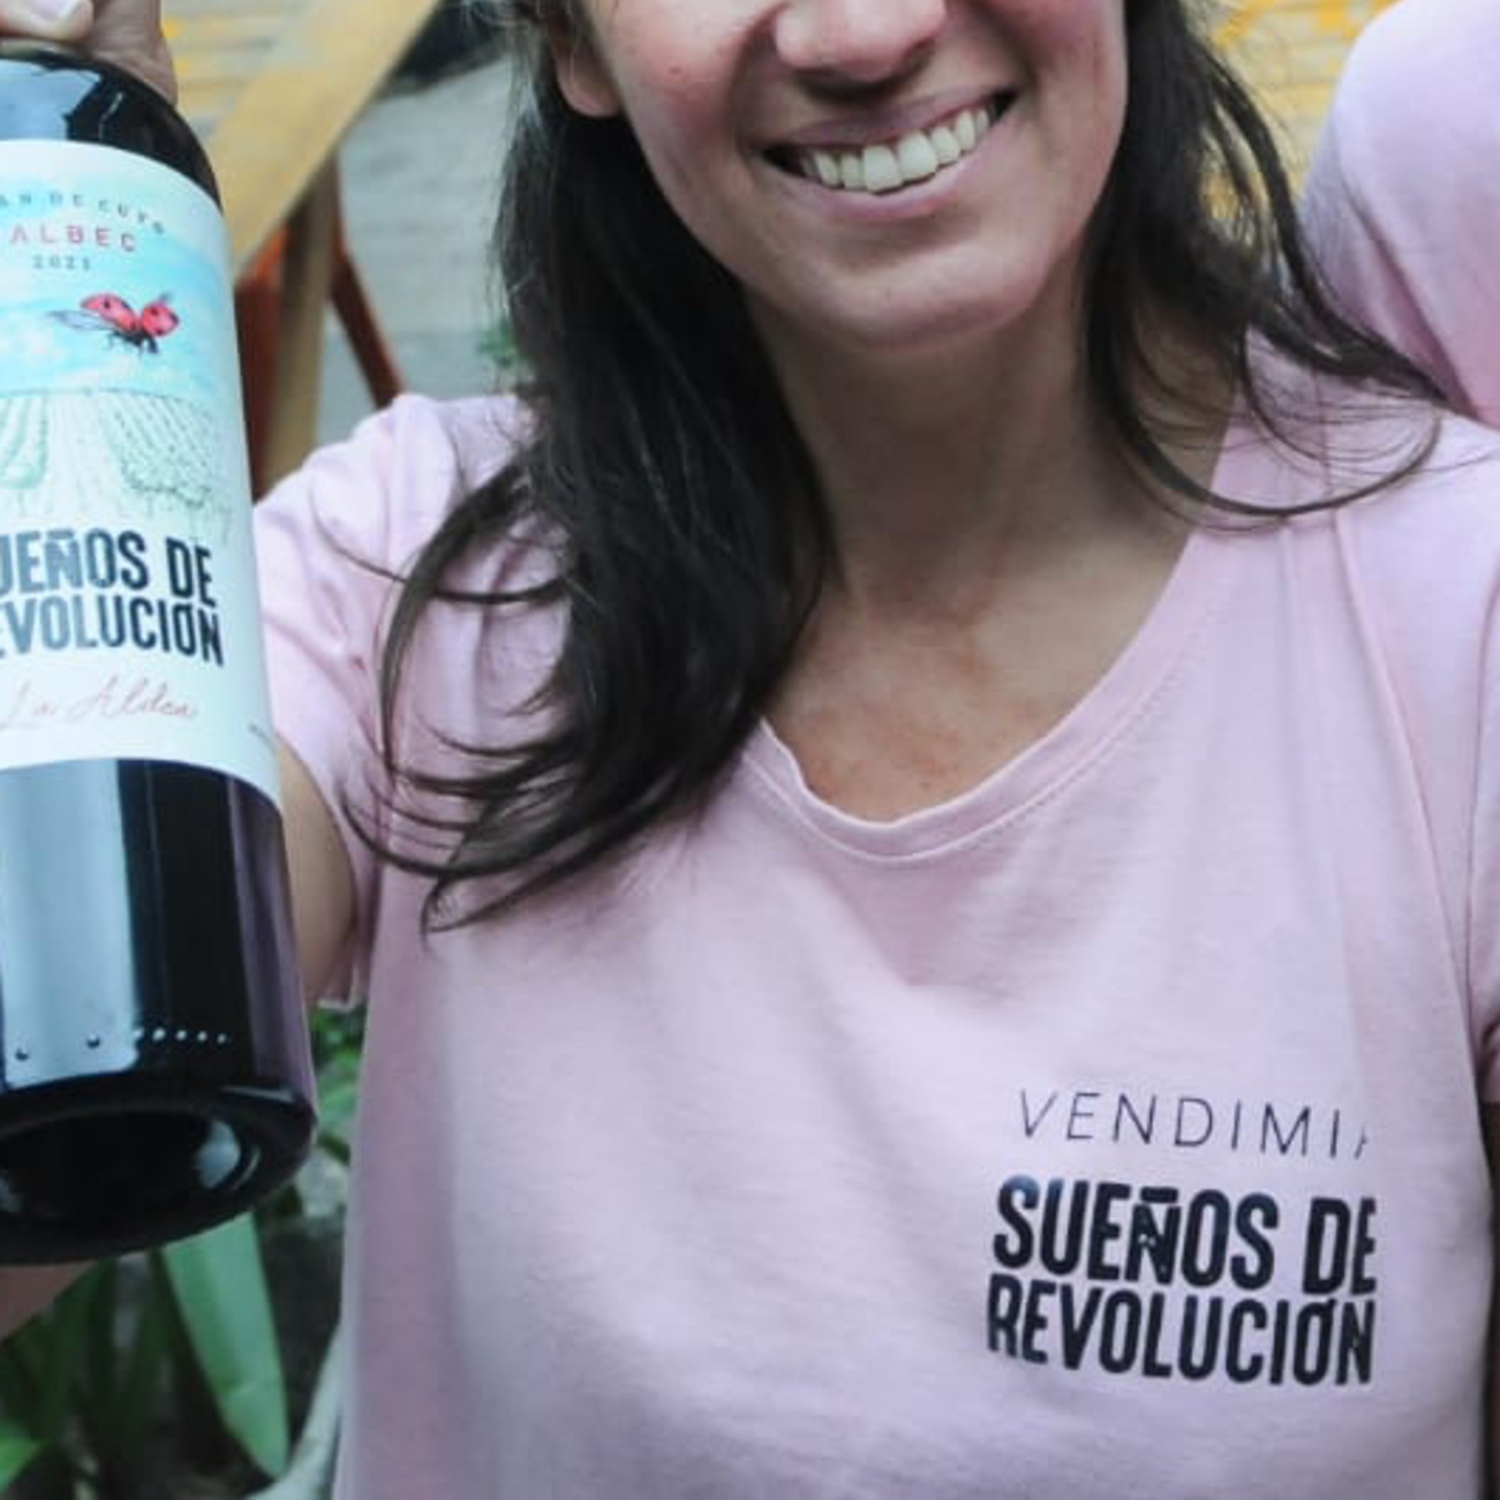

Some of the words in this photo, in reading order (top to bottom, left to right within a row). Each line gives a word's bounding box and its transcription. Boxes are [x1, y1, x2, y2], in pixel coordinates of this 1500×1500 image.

[165, 536, 216, 609] DE
[0, 595, 223, 667] VOLUCIÓN
[993, 1174, 1278, 1291] SUEÑOS
[1302, 1197, 1377, 1296] DE
[987, 1273, 1377, 1387] REVOLUCIÓN
